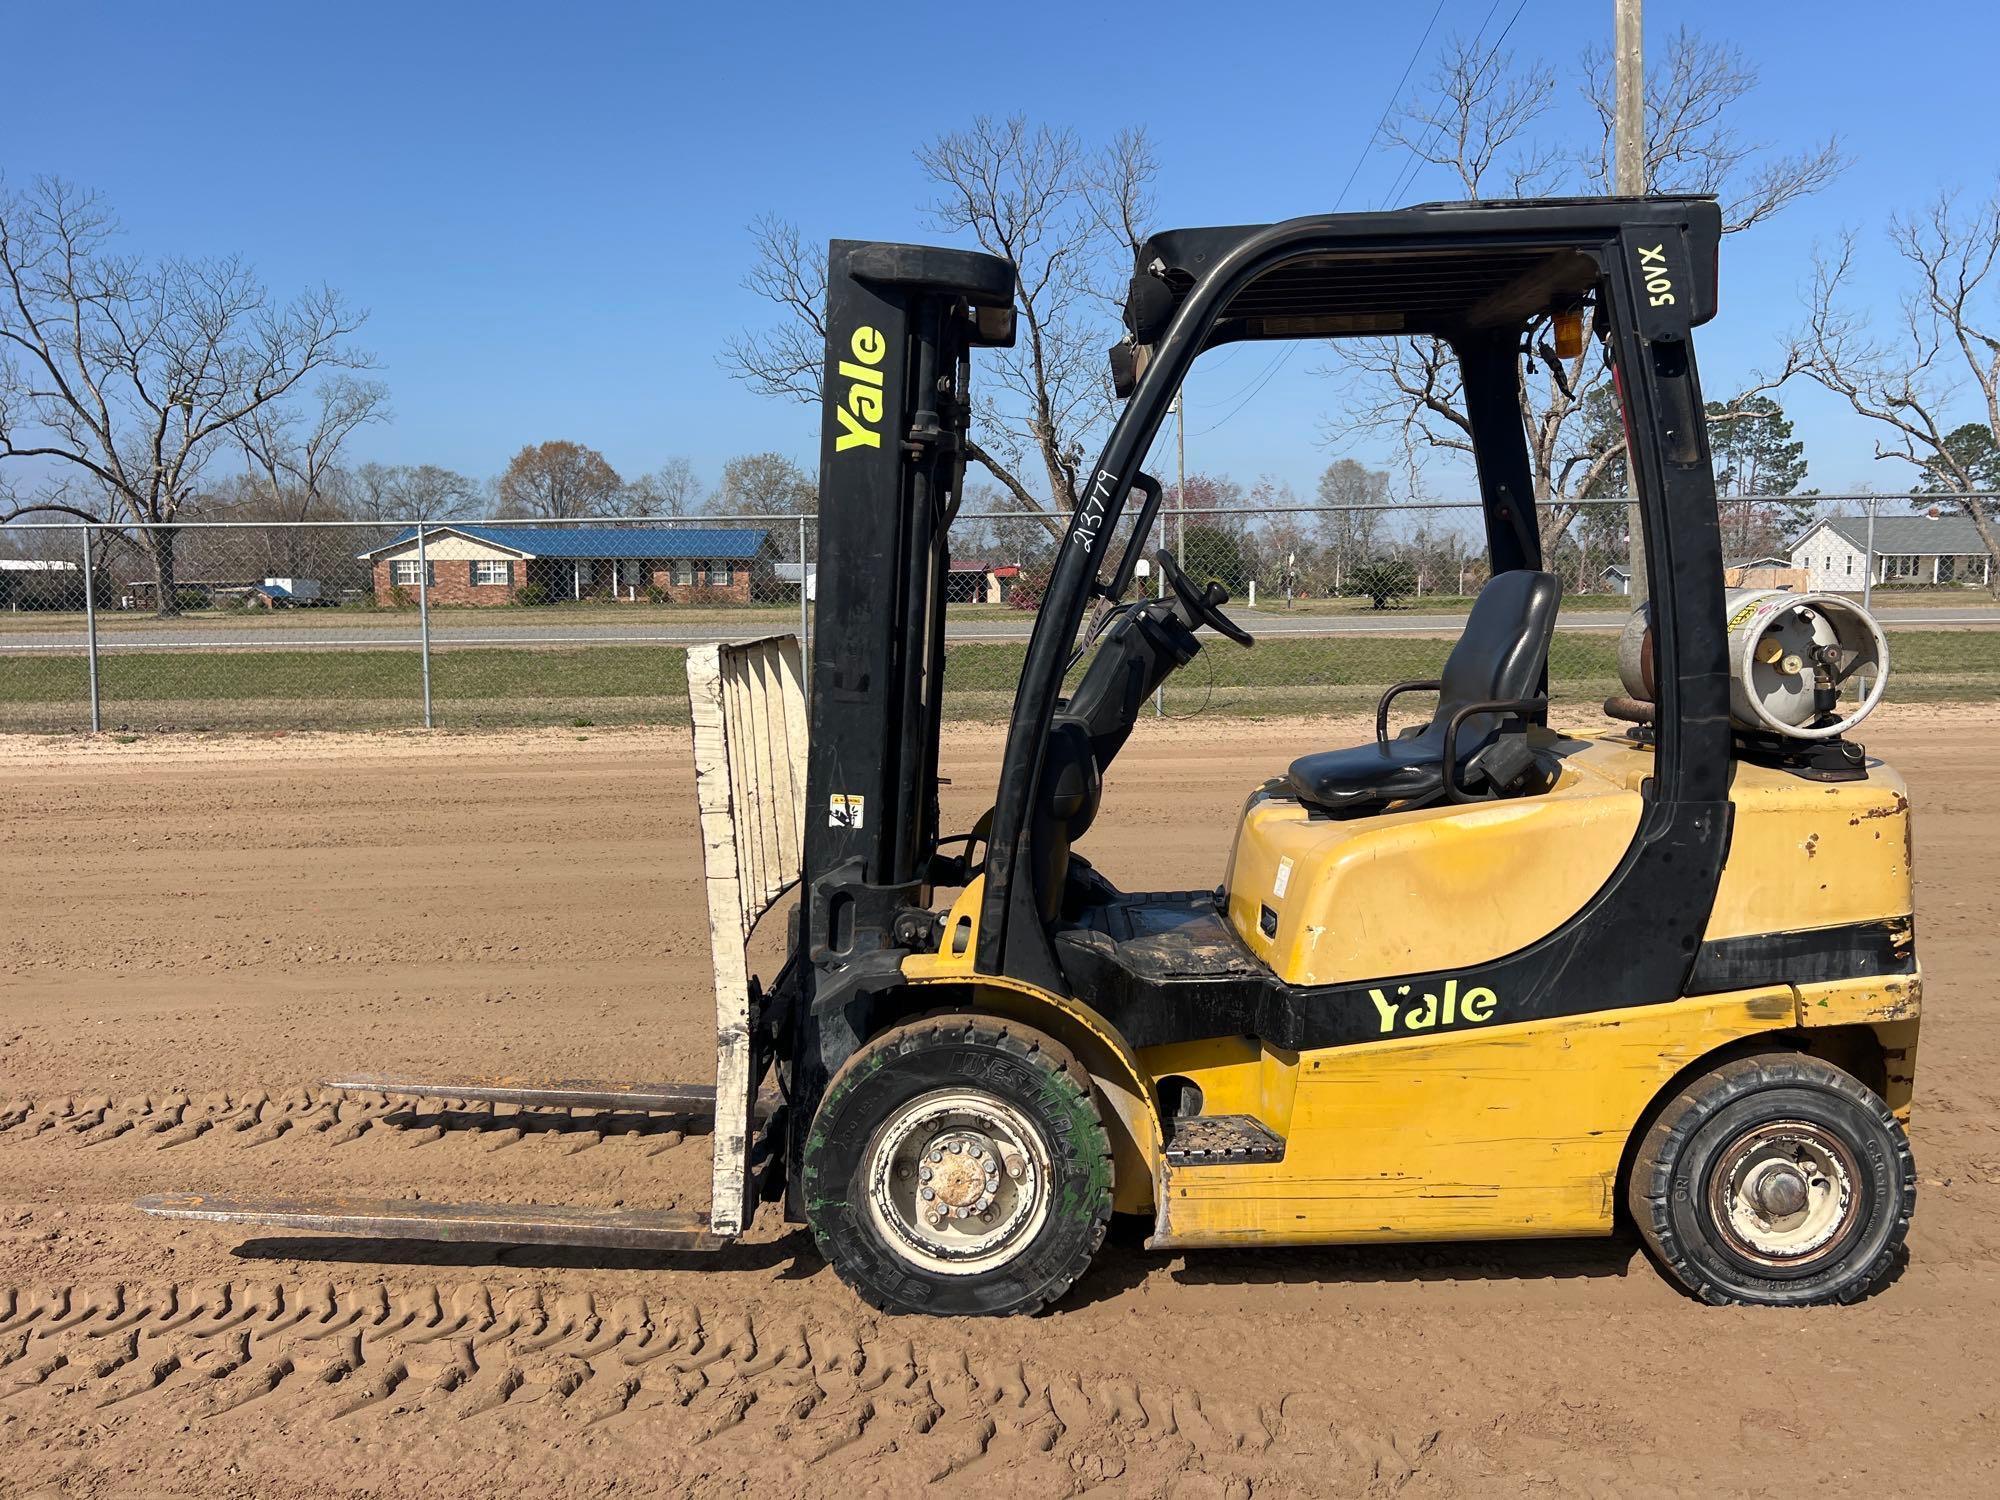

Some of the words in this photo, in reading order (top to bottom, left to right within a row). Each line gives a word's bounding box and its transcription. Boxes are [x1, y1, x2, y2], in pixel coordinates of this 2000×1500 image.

[1637, 243, 1676, 307] 50VX
[835, 325, 887, 453] Yale
[1072, 469, 1118, 554] 213779
[1368, 979, 1498, 1033] Yale
[1675, 1174, 1689, 1201] GRI
